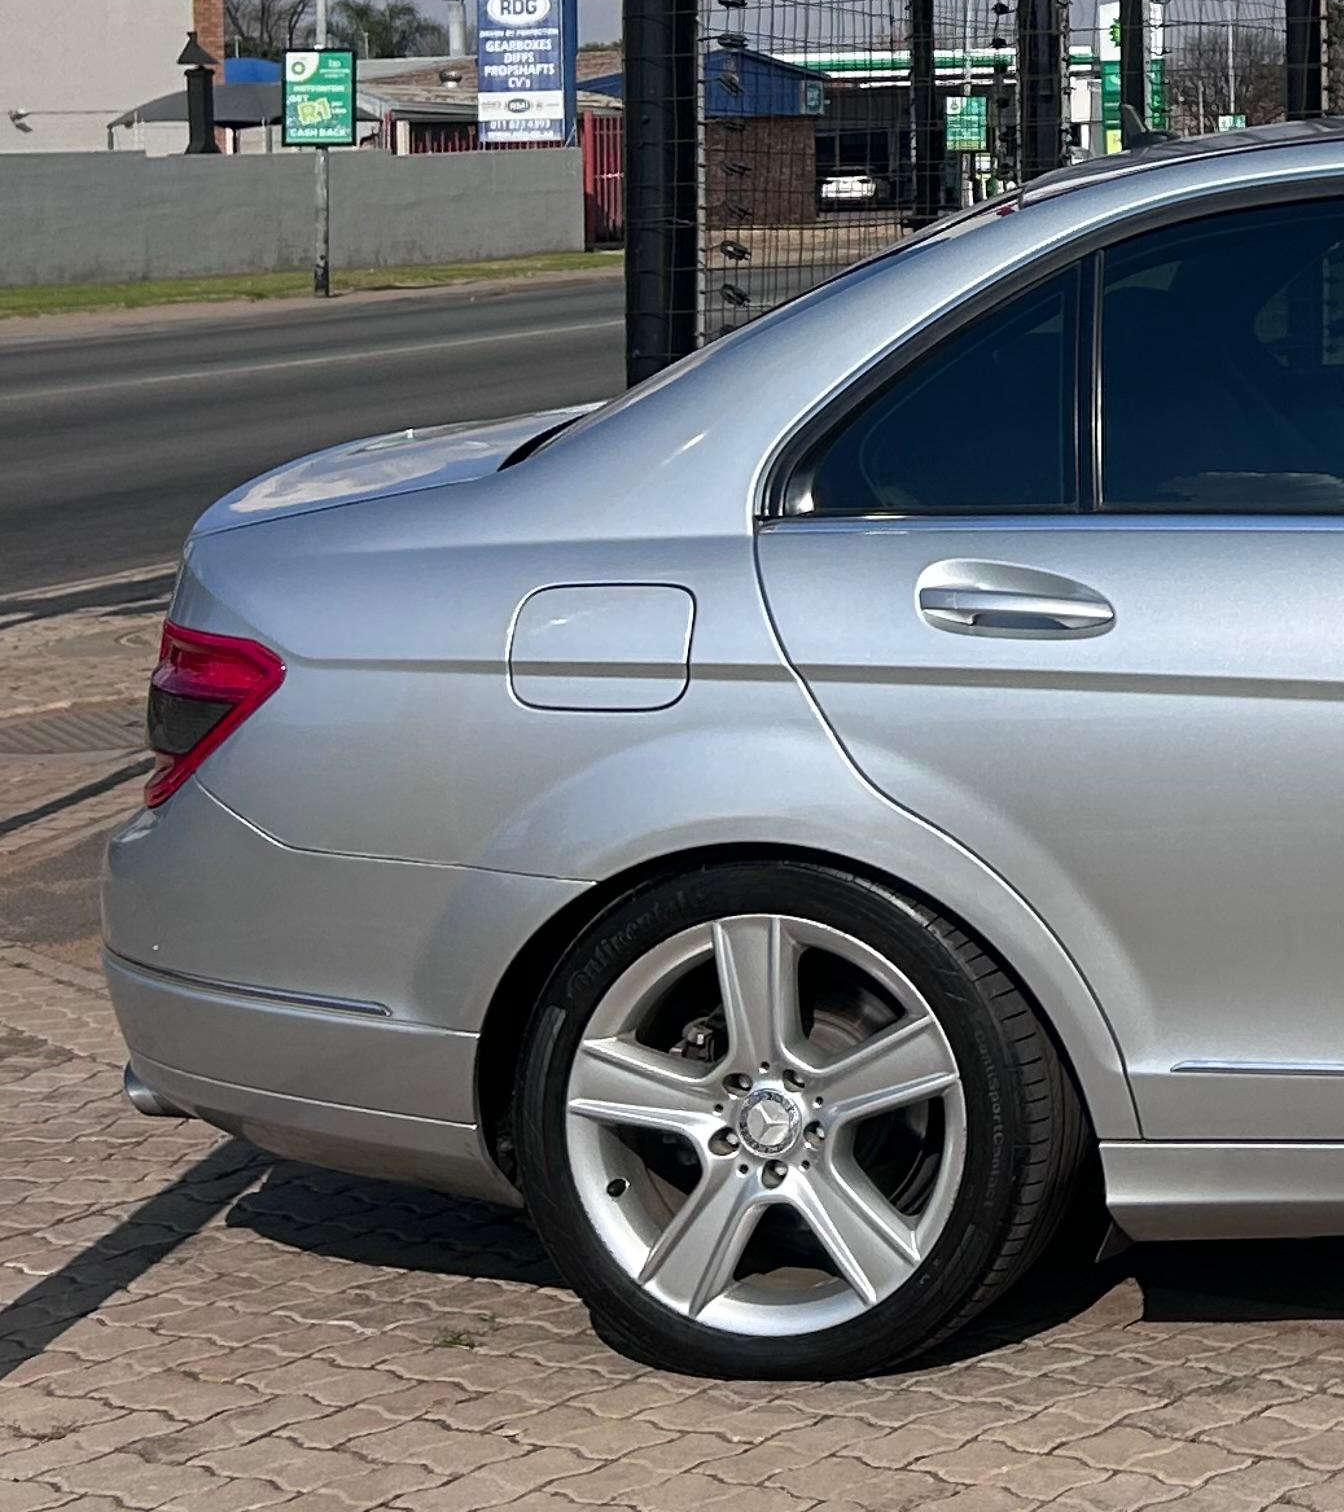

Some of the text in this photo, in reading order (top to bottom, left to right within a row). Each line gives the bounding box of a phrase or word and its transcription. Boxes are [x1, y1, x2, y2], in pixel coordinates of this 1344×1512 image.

[485, 39, 552, 53] GEARBOXES
[503, 51, 535, 64] DIFFS
[484, 63, 555, 77] PROPSHAFTS
[290, 128, 347, 137] CASH BACK
